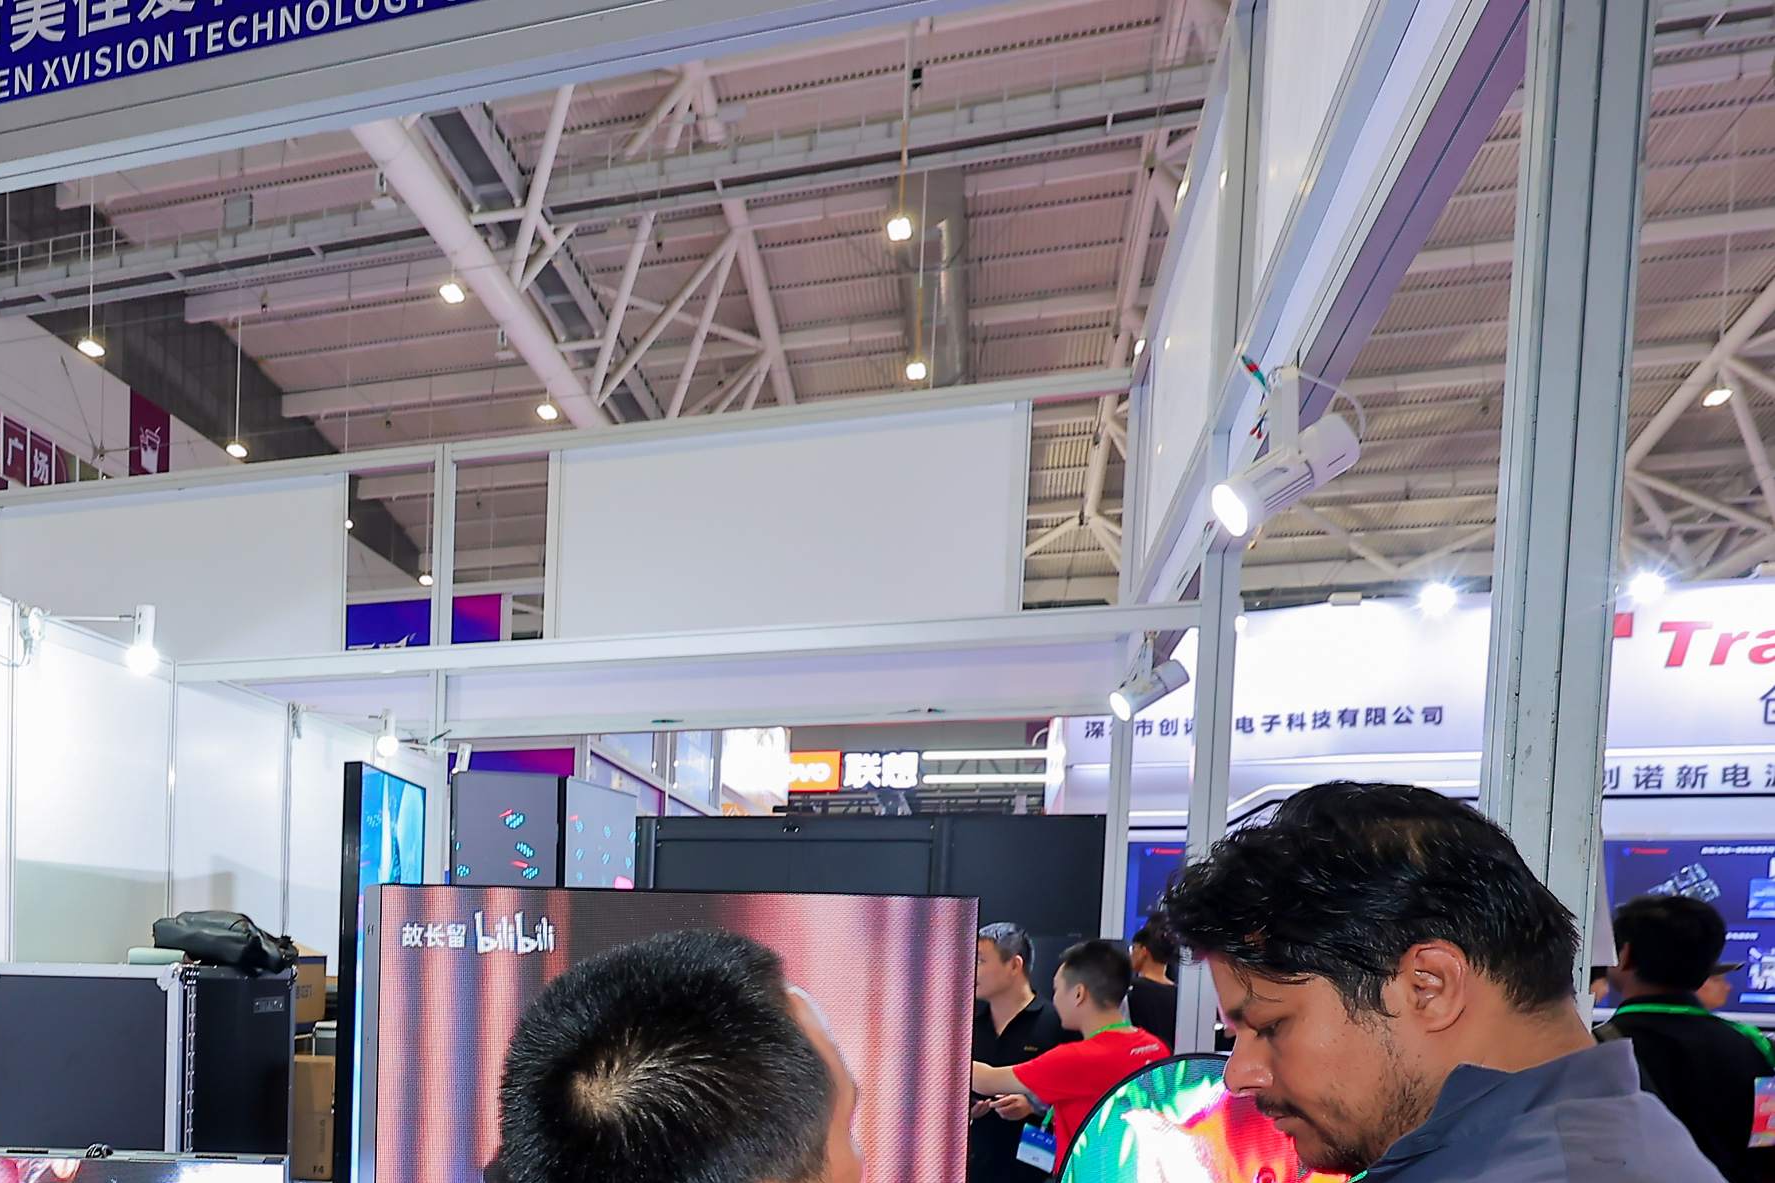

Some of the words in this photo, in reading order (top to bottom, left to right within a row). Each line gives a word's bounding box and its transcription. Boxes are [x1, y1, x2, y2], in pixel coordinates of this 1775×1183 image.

[41, 31, 175, 91] XVISION
[183, 0, 423, 57] TECHNOLO
[1084, 705, 1445, 740] 深市创电子科技有限公司
[474, 910, 556, 955] bilibili
